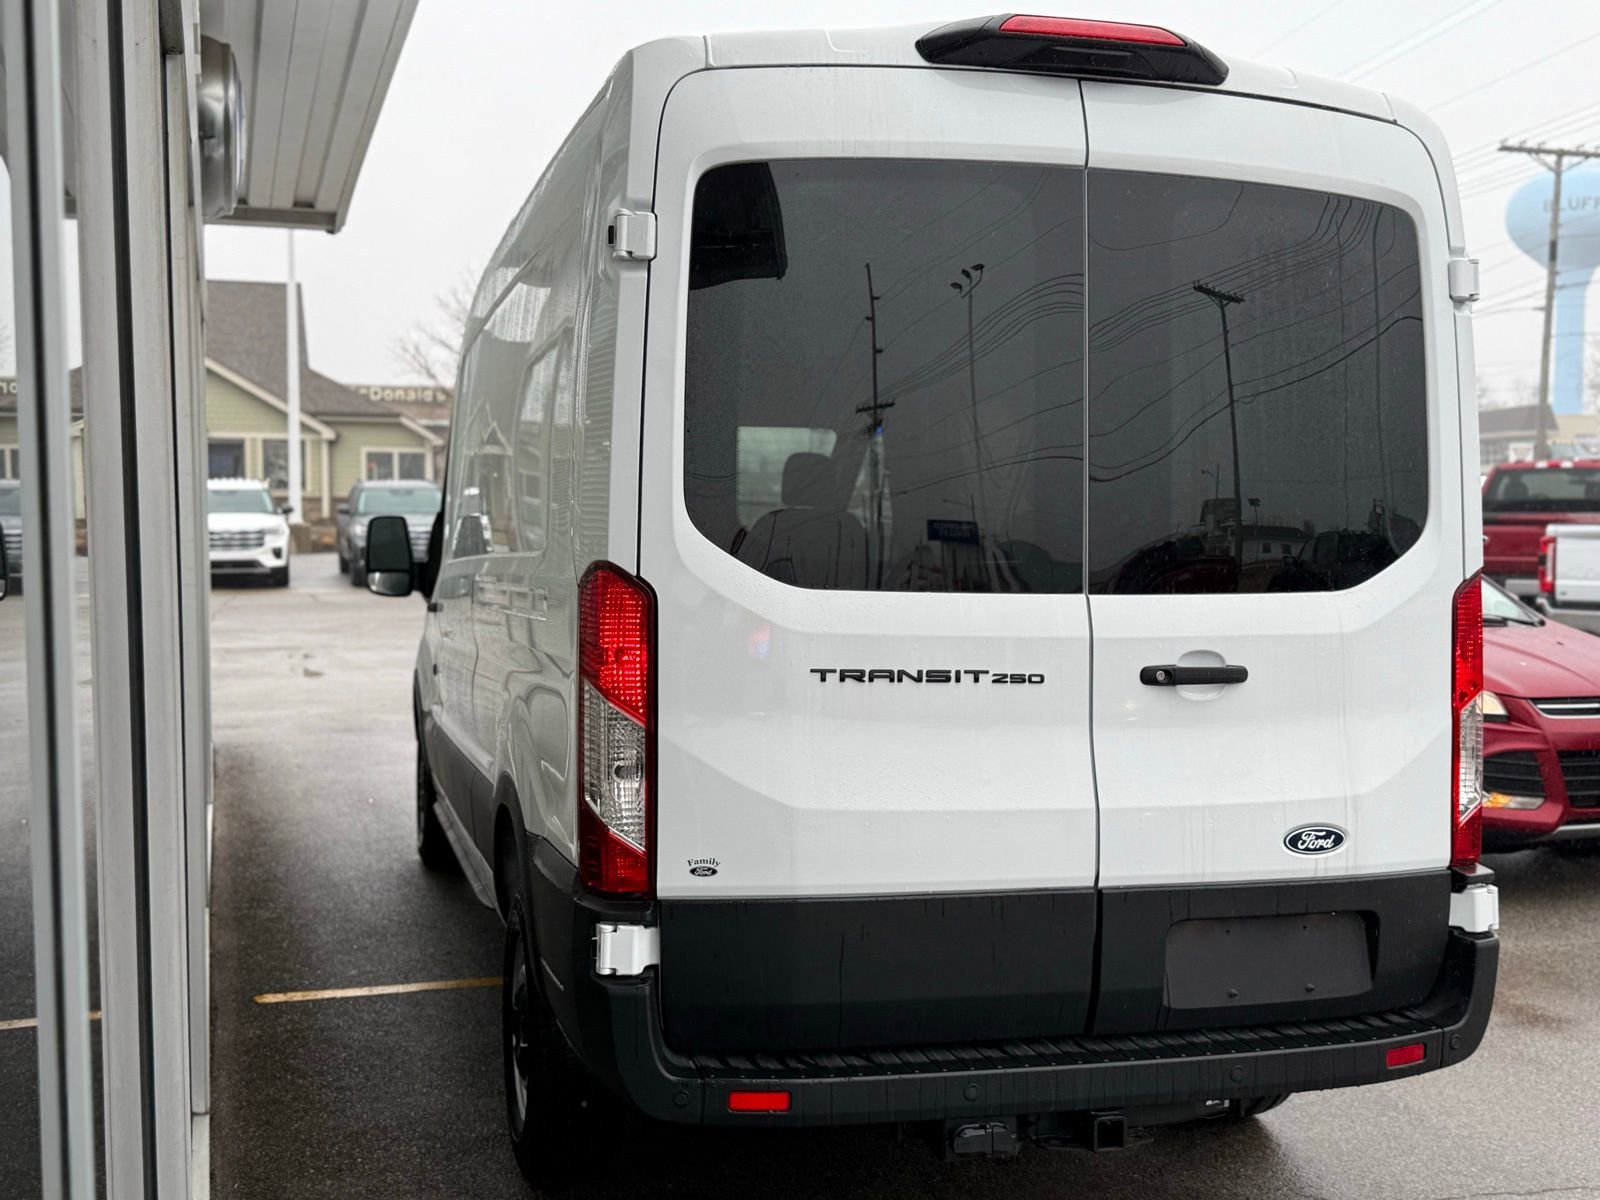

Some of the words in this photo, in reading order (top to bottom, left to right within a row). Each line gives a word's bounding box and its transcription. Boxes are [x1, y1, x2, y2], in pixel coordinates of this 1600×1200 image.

[351, 385, 447, 402] Donald's
[810, 668, 989, 683] TRANSIT
[992, 673, 1045, 684] 250
[1297, 831, 1336, 849] Ford
[687, 857, 721, 867] Family
[694, 867, 713, 876] Ford
